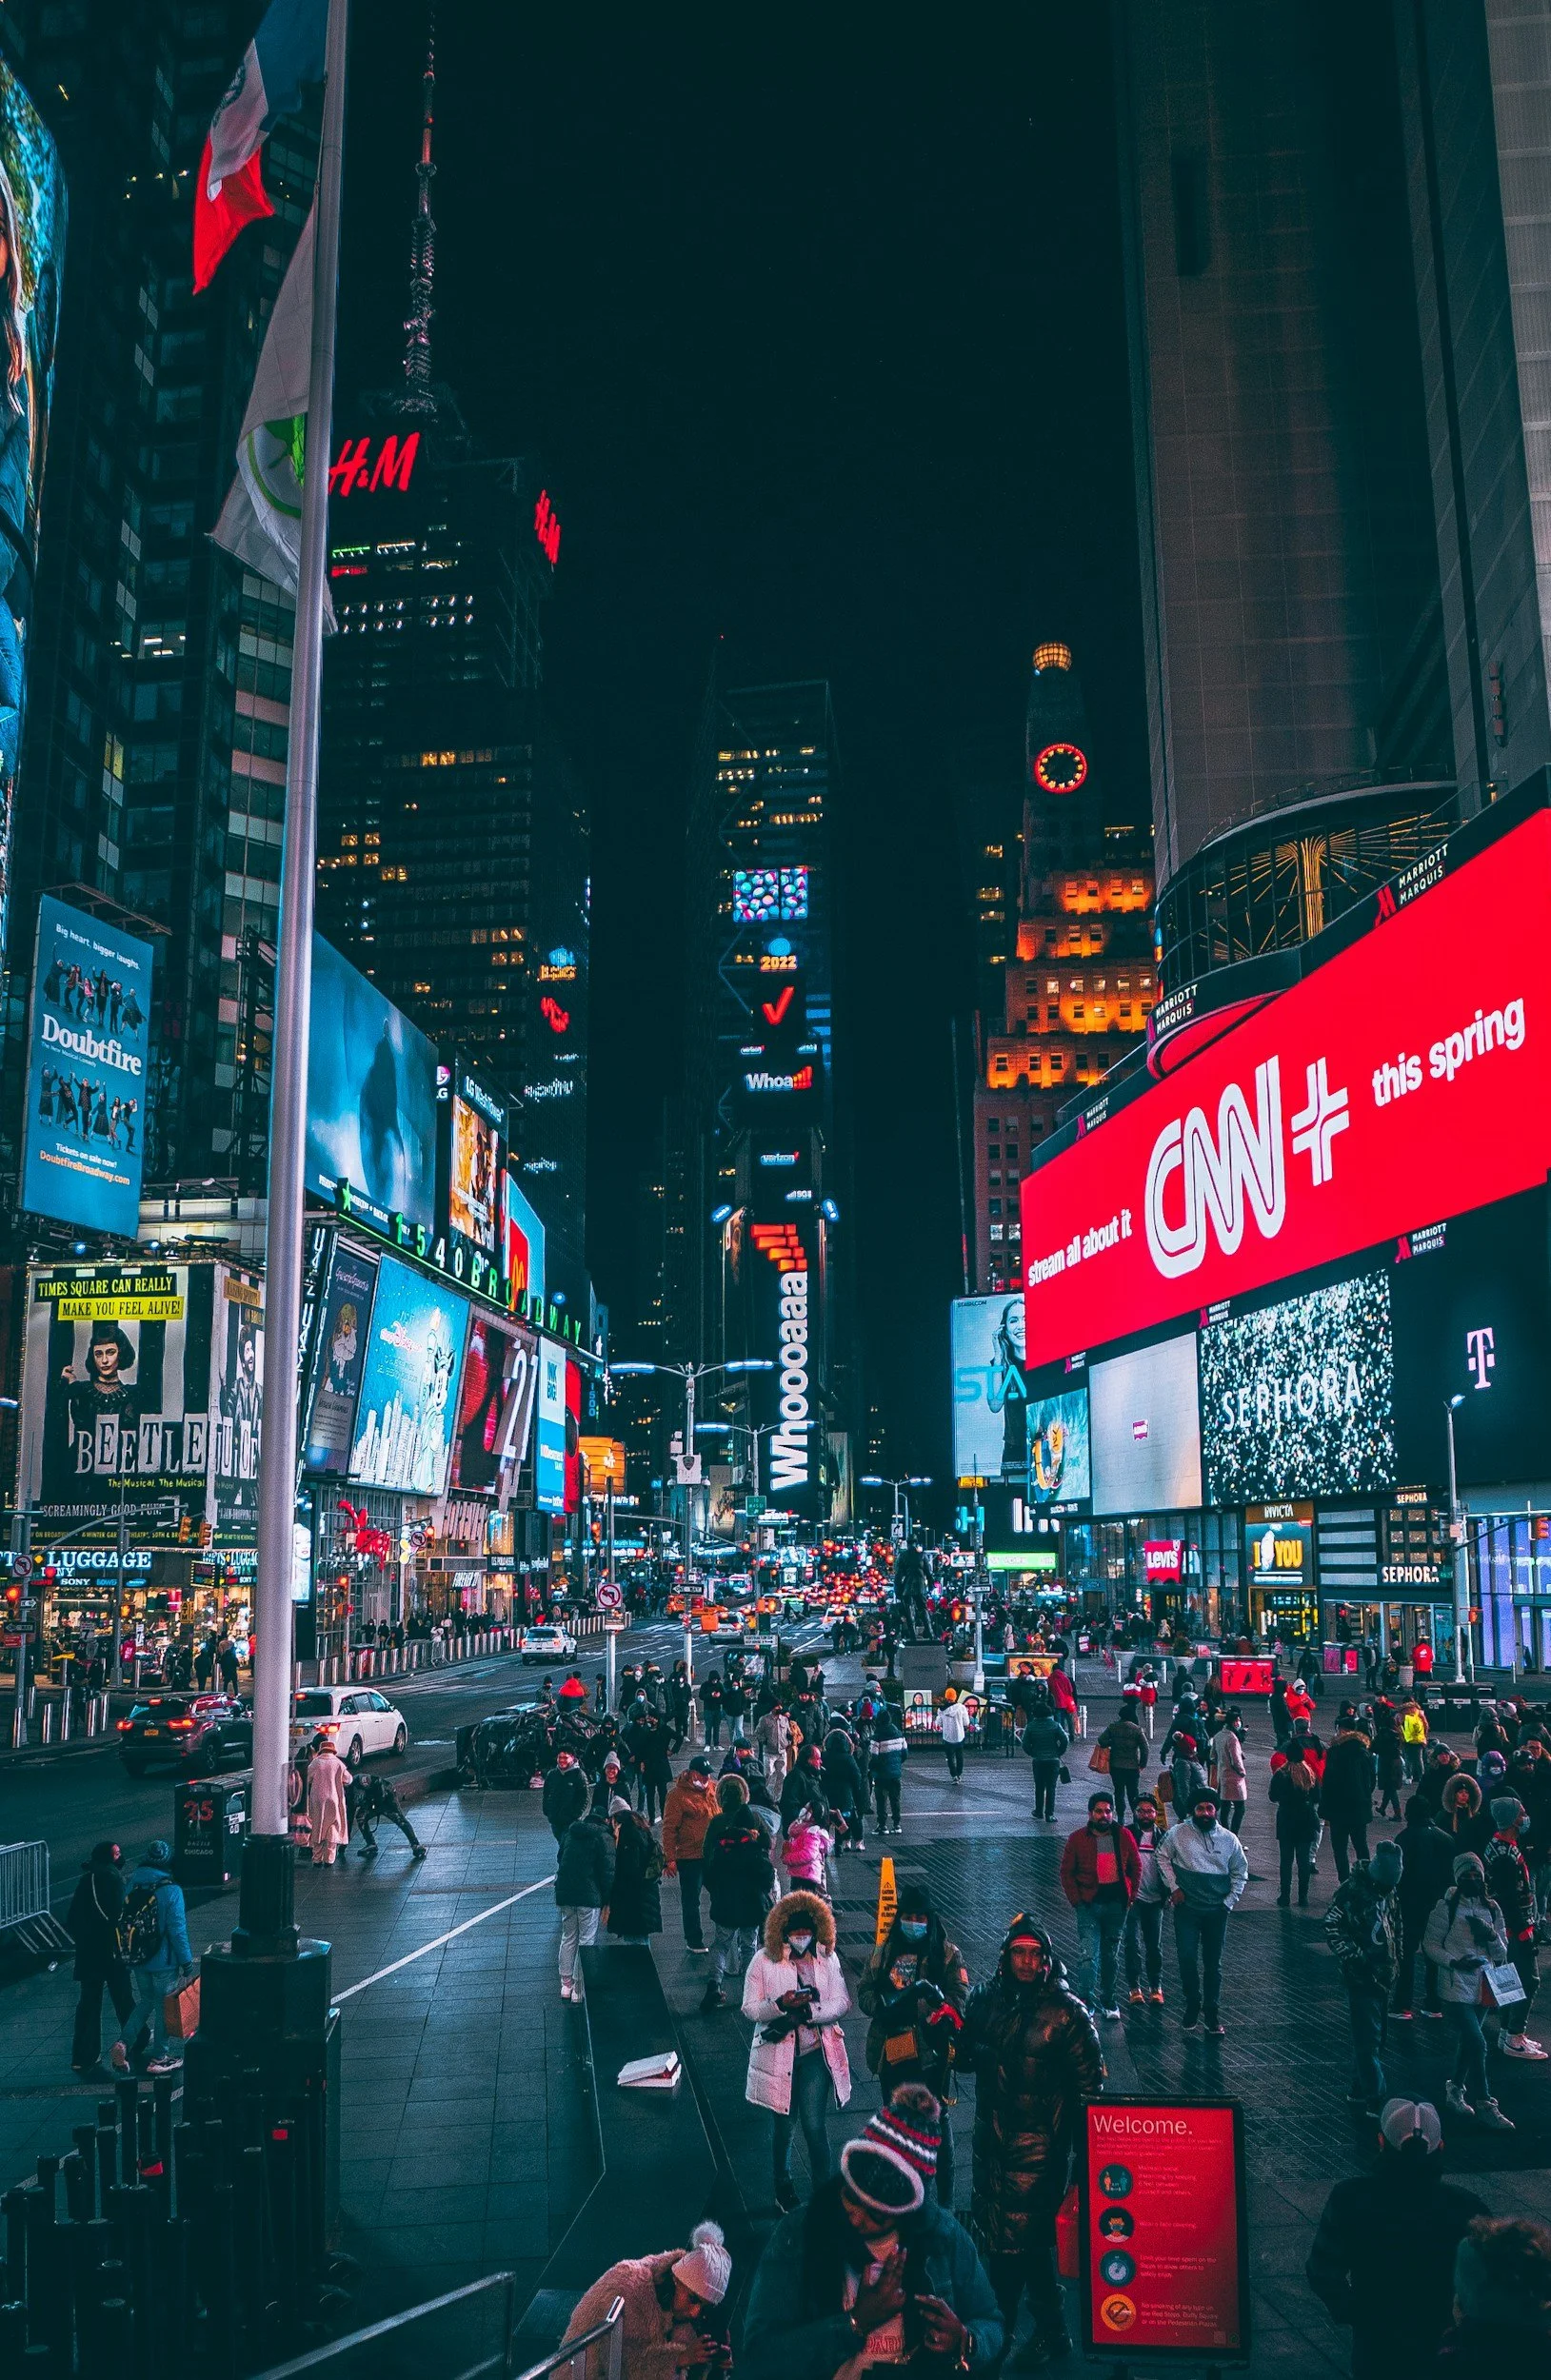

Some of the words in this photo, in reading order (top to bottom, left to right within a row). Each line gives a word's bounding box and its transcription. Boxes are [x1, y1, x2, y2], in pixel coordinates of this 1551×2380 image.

[328, 432, 420, 497] H&M
[1399, 843, 1448, 889] MARRIOTT
[1400, 865, 1443, 905] MARQUIS
[55, 923, 68, 939] Big
[92, 941, 115, 958] bigger
[760, 955, 797, 971] 2022
[1156, 983, 1198, 1019] MARRIOTT
[1157, 1002, 1192, 1035] MARQUIS
[42, 1013, 142, 1076] Doubtfire
[437, 1088, 448, 1100] G
[56, 1142, 79, 1158] Tickets
[79, 1152, 89, 1160] on
[89, 1154, 101, 1164] sale
[102, 1159, 117, 1169] now!
[1028, 1259, 1066, 1287] stream
[1066, 1235, 1082, 1268] all
[1083, 1216, 1120, 1259] about
[1121, 1208, 1132, 1239] it
[1372, 1052, 1423, 1107] this
[1430, 999, 1525, 1081] spring
[40, 1149, 130, 1185] DoubtfireBroadway.com
[1412, 1222, 1447, 1243] MARRIOTT
[1413, 1237, 1444, 1256] MARQUIS
[39, 1281, 69, 1297] TIMES
[71, 1279, 109, 1297] SQUARE
[111, 1278, 131, 1293] CAN
[135, 1277, 172, 1292] REALLY
[394, 1213, 464, 1279] 1540
[471, 1251, 582, 1345] BROADWAY
[63, 1301, 91, 1316] MAKE
[96, 1301, 115, 1316] YOU
[119, 1301, 144, 1315] FEEL
[148, 1300, 180, 1315] ALIVE!
[1468, 1328, 1495, 1389] T
[1222, 1360, 1363, 1431] SEPHORA
[108, 1478, 121, 1488] The
[159, 1478, 175, 1487] The
[1263, 1504, 1294, 1518] INVICTA
[1396, 1492, 1427, 1505] SEPHORA
[47, 1550, 152, 1570] LUGGAGE
[1274, 1539, 1303, 1568] YOU
[1092, 2114, 1194, 2136] Welcome.
